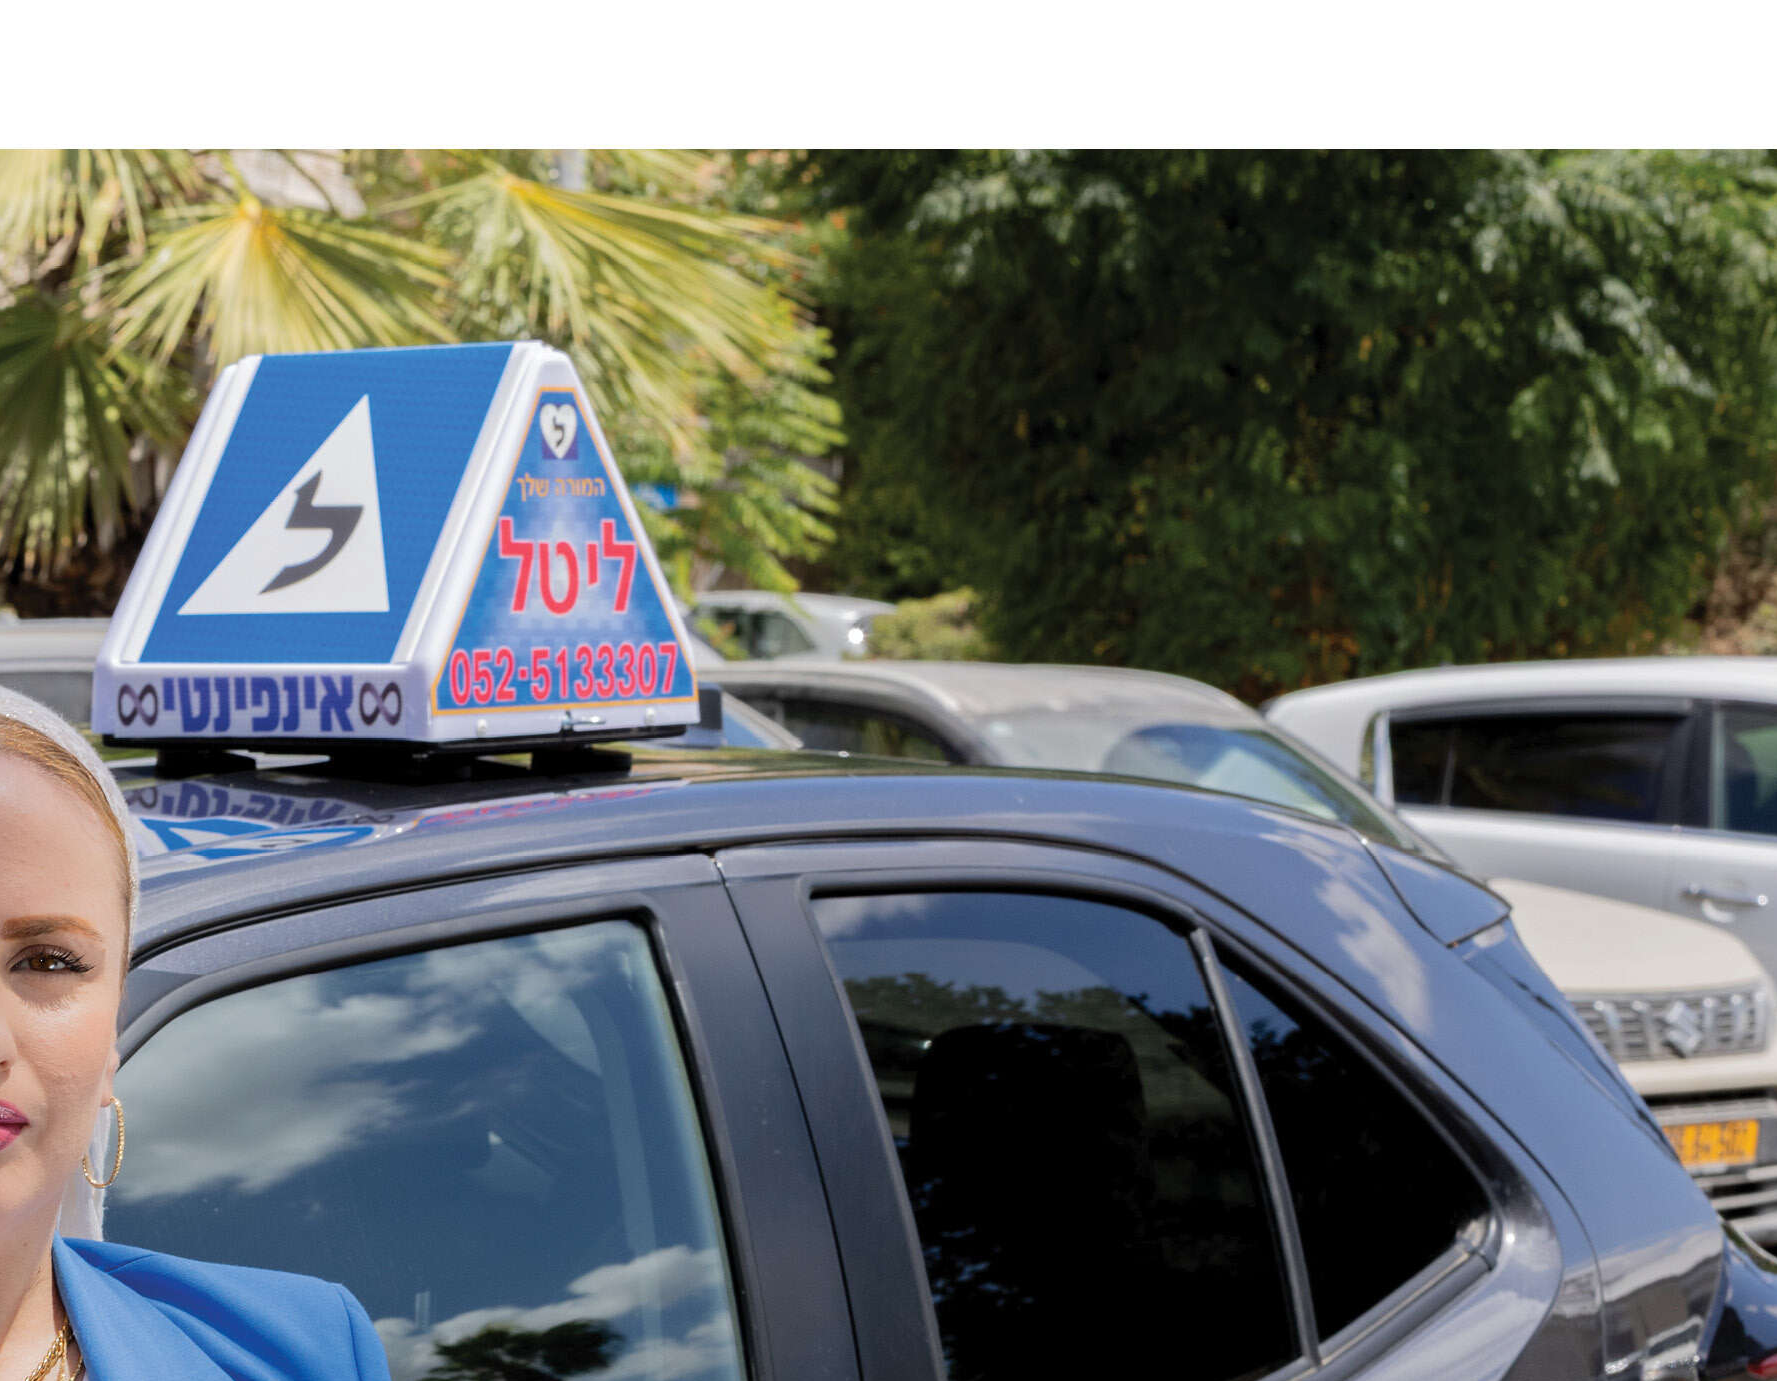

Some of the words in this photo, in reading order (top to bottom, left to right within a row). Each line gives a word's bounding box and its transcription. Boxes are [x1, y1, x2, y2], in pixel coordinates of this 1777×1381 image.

[517, 472, 549, 502] שלך
[555, 477, 606, 497] המורה
[258, 469, 363, 594] ל
[499, 517, 636, 616] ליטל
[162, 675, 355, 734] אינפינטי
